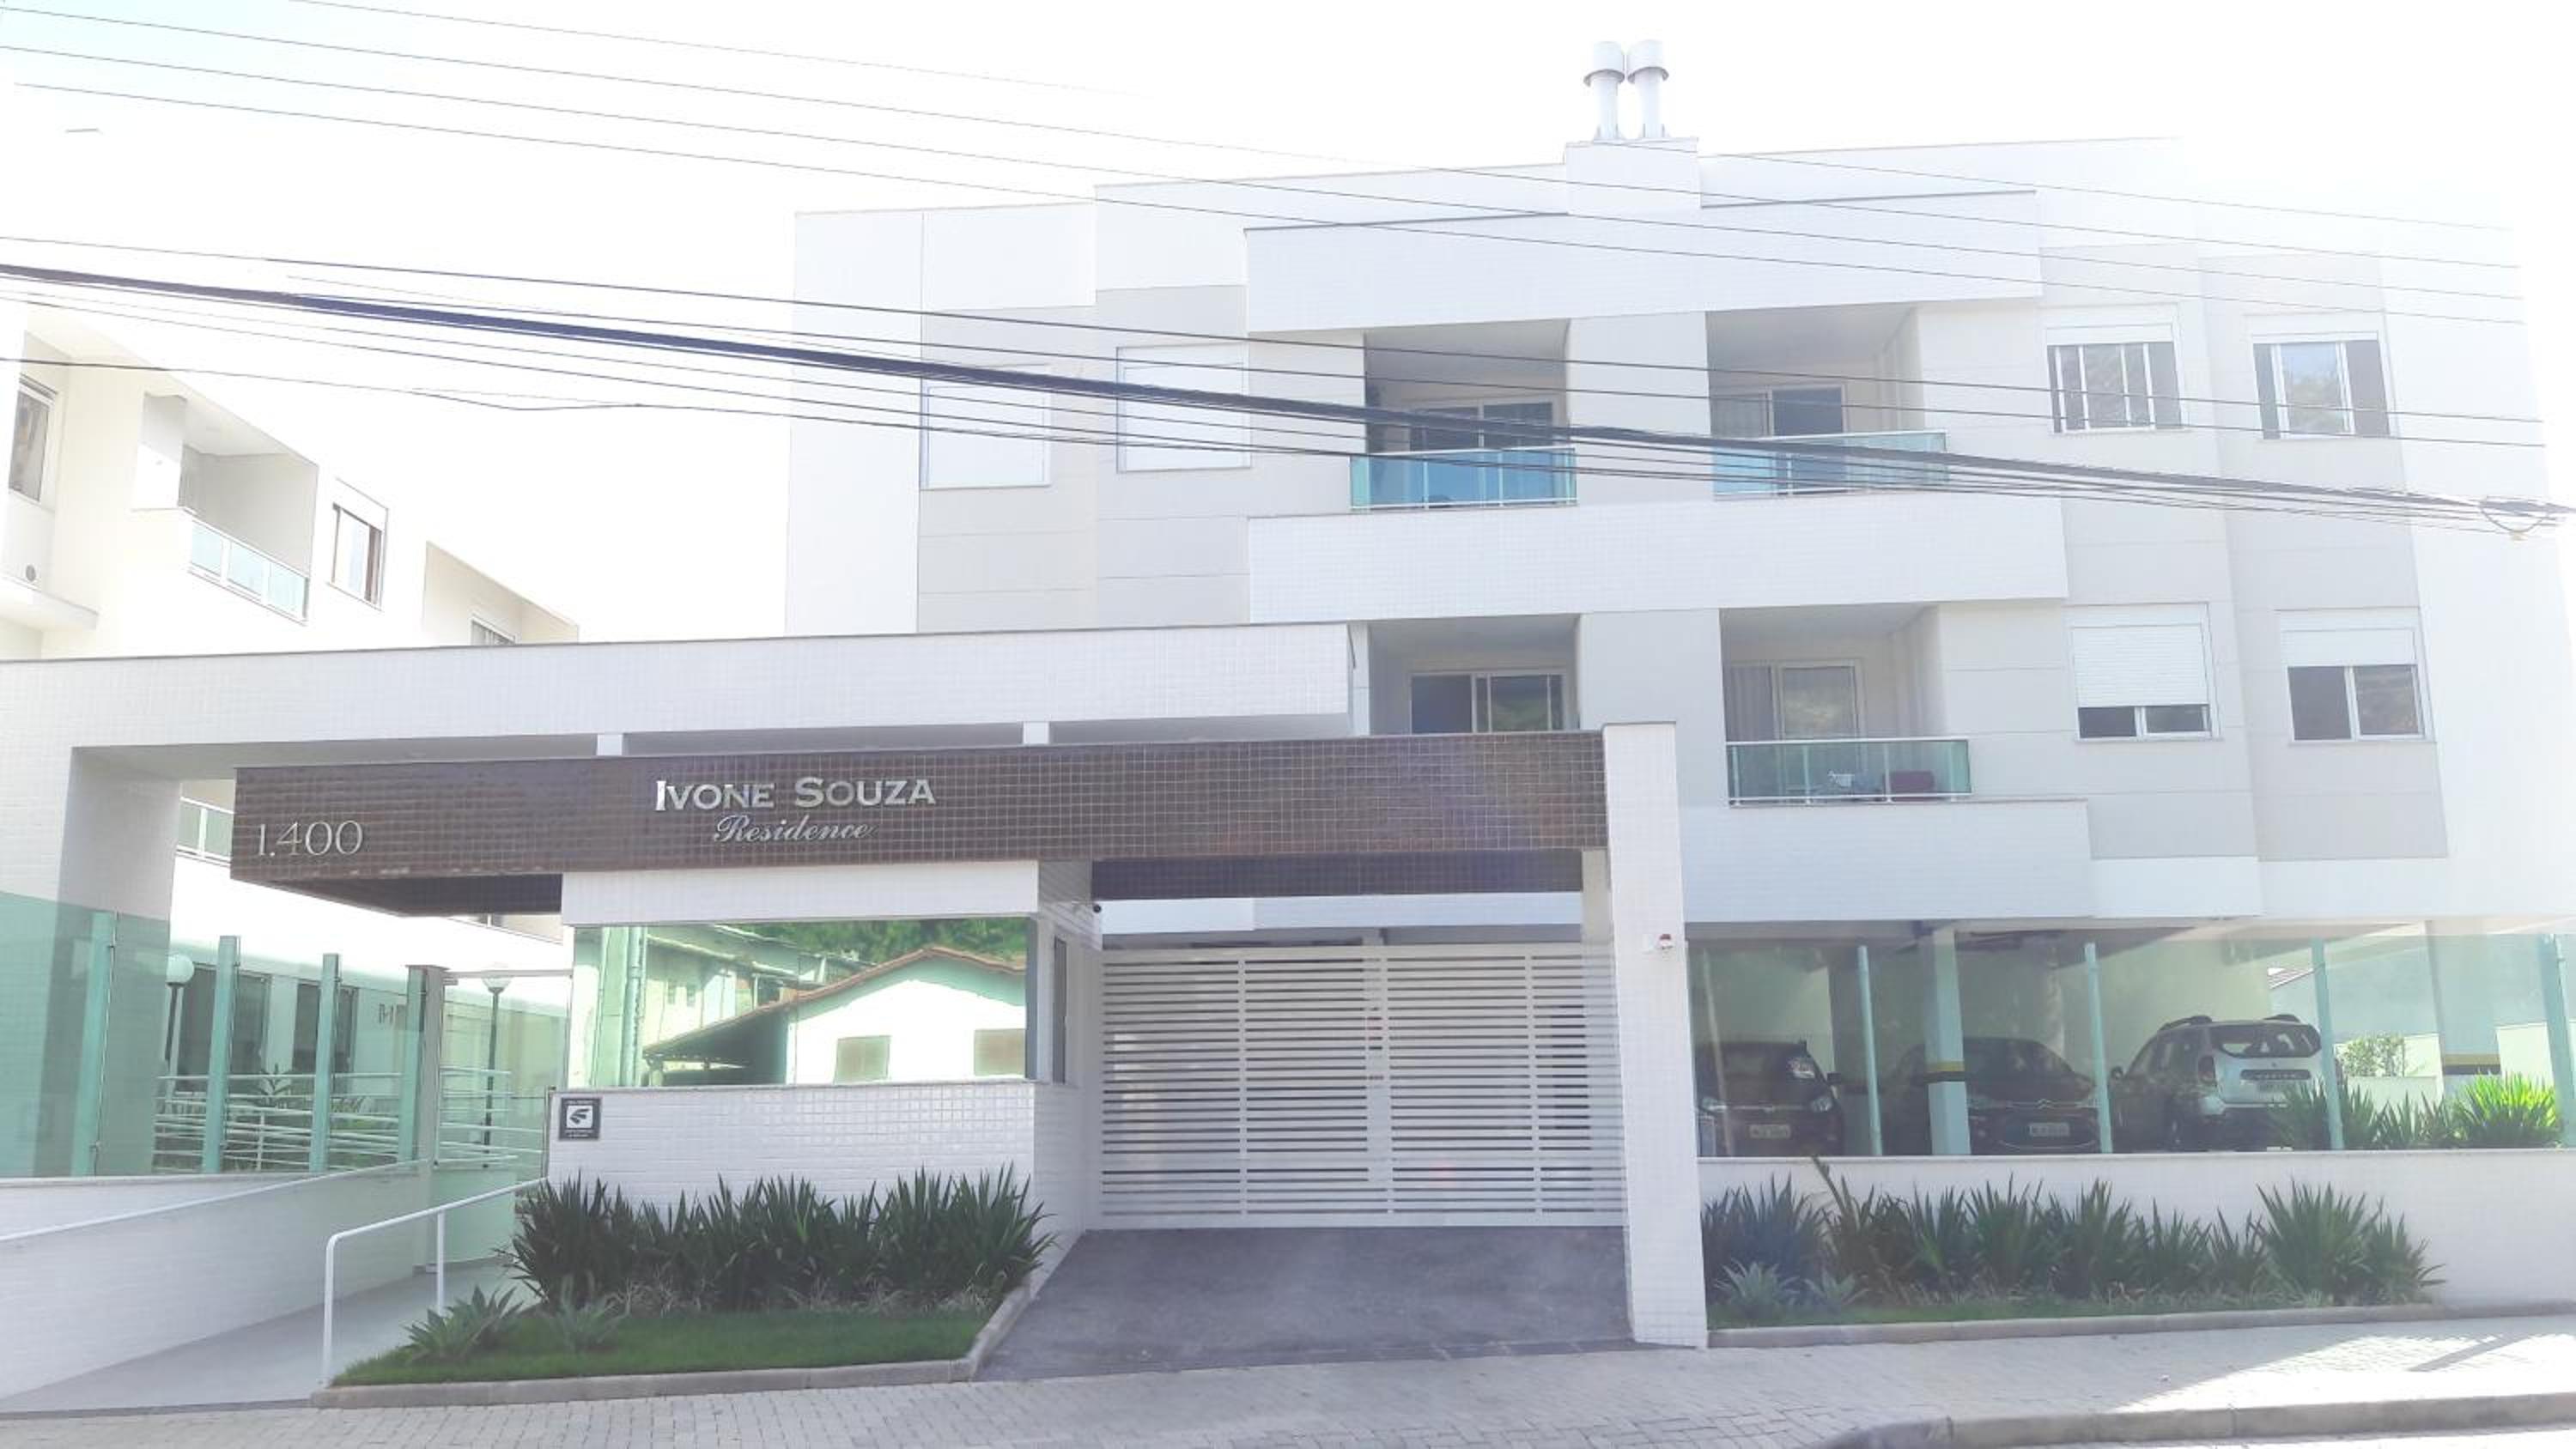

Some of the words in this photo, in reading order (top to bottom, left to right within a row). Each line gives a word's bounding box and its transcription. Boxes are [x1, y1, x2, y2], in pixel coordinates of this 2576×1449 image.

[655, 780, 775, 811] IVONE
[795, 777, 937, 808] SOUZA
[259, 820, 363, 856] 1.400
[714, 815, 878, 842] Residence
